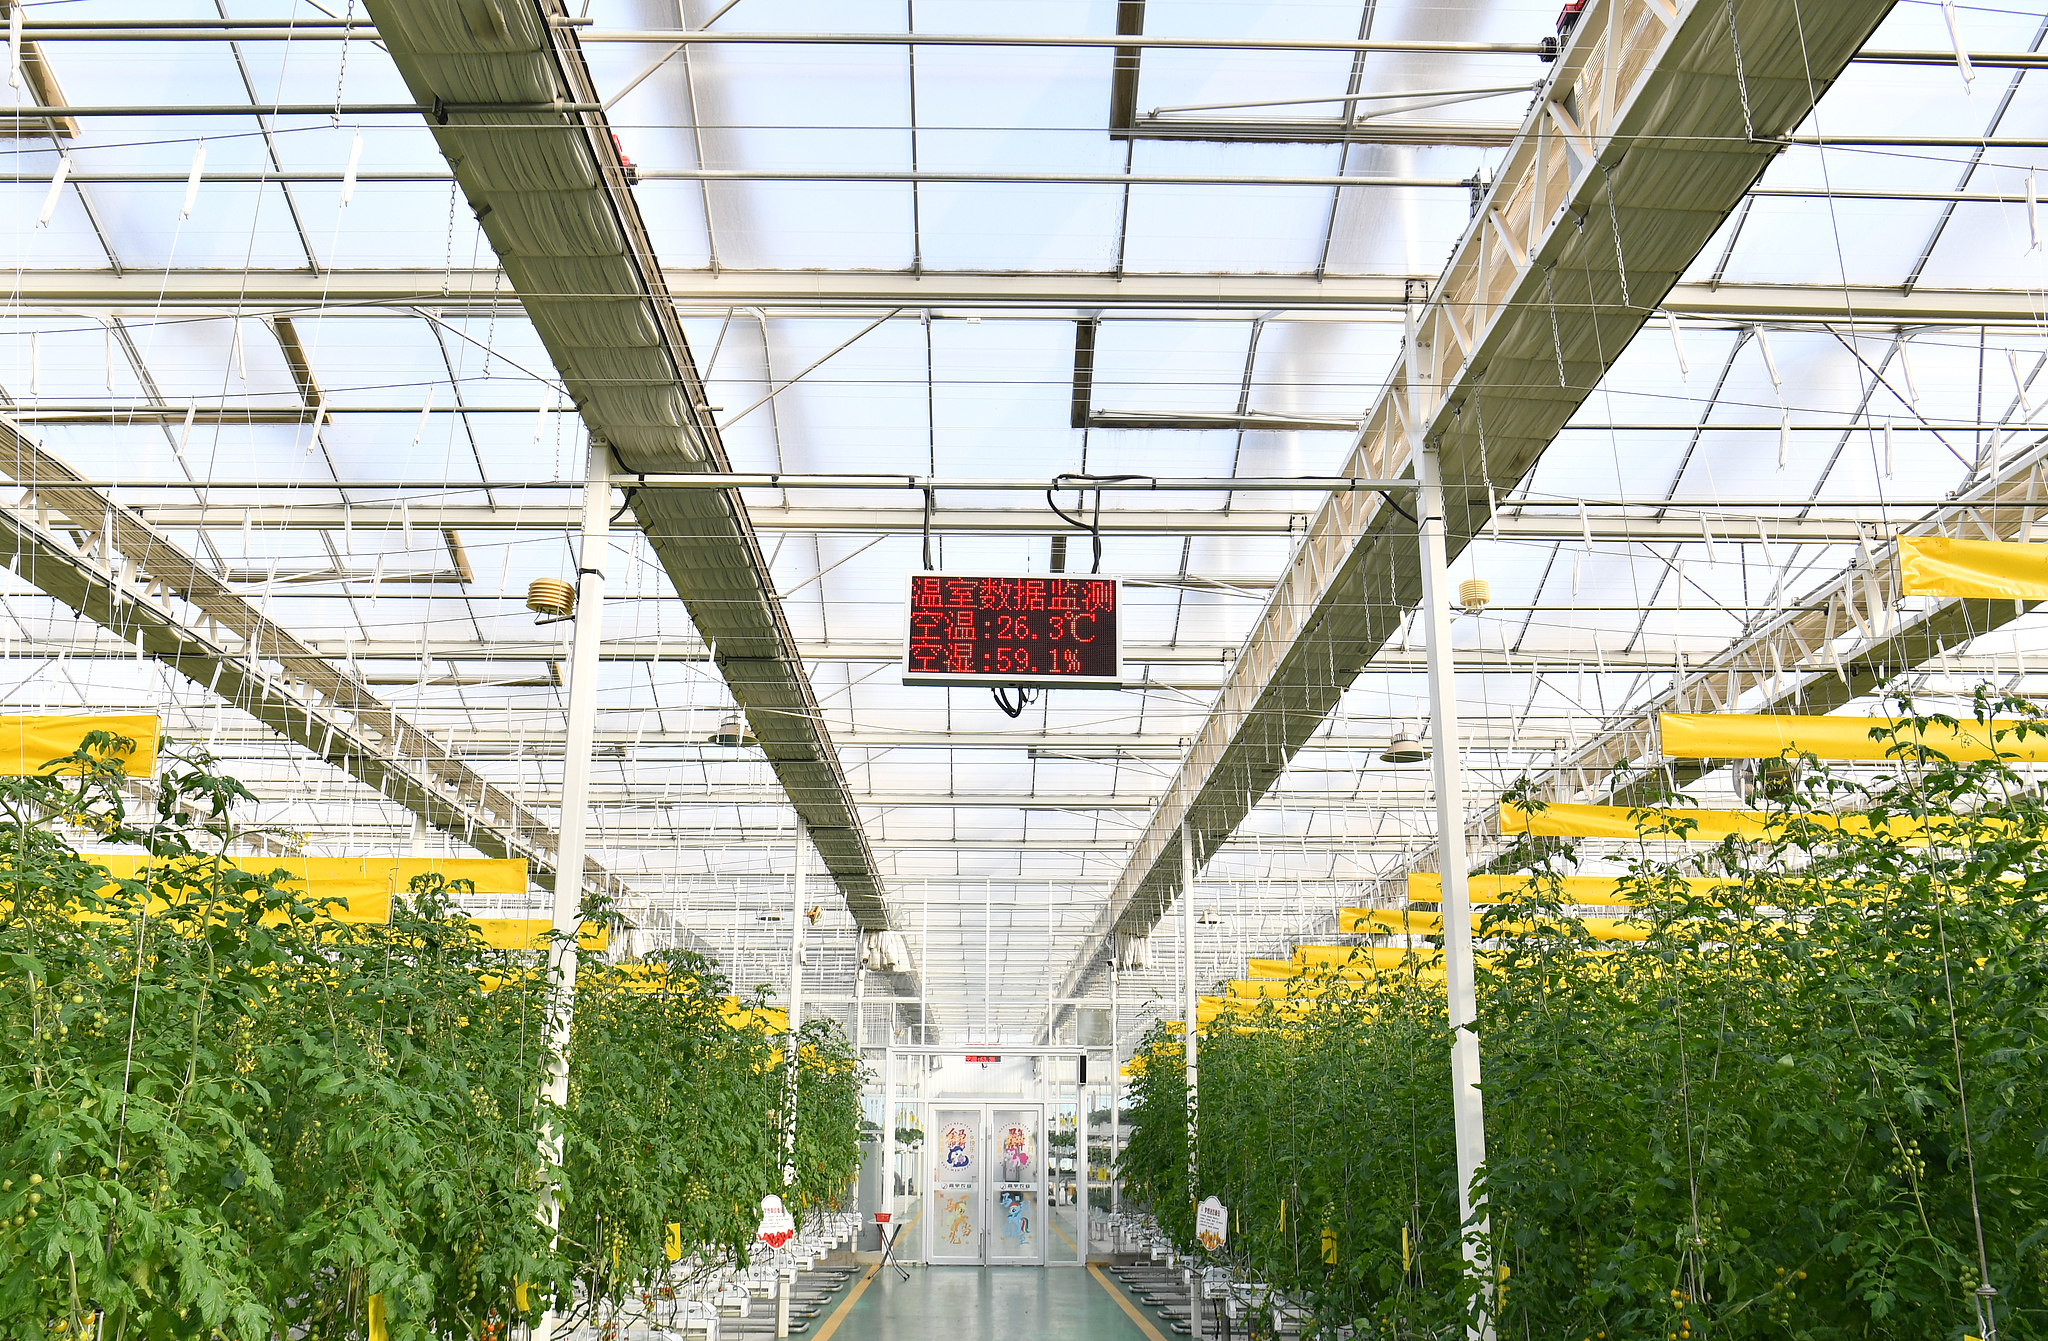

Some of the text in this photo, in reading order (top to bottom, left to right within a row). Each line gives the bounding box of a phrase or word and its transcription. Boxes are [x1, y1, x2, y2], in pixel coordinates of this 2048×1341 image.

[911, 577, 1113, 612] 温室数据监测
[909, 640, 1081, 673] 空湿:59.1%
